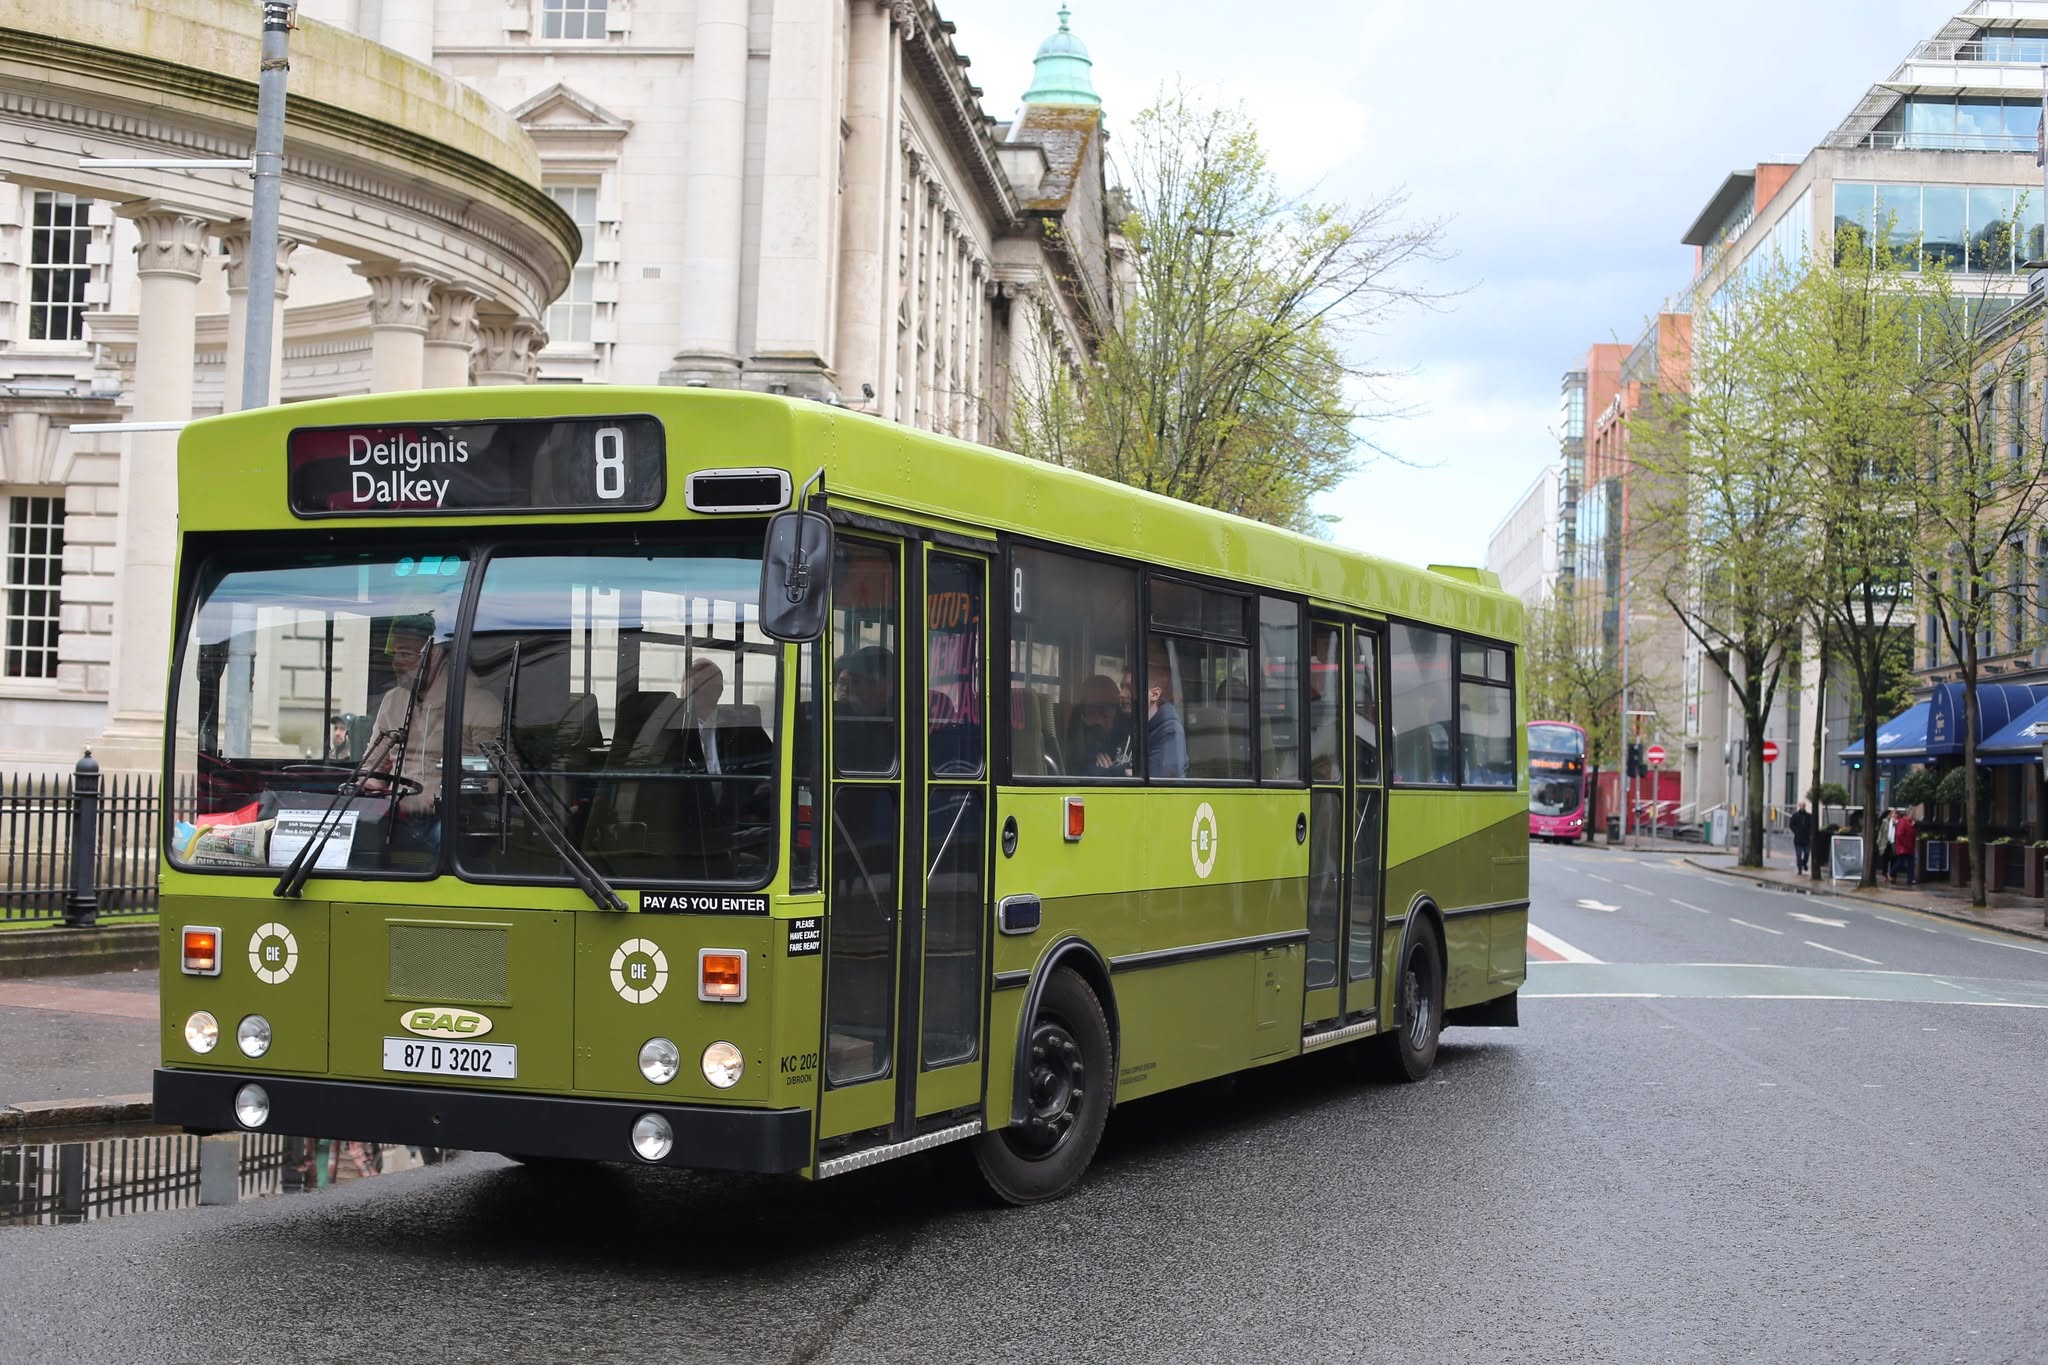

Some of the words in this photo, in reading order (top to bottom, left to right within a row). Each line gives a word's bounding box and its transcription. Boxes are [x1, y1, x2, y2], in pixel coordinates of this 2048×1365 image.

[349, 433, 469, 472] Deilginis
[595, 427, 625, 499] 8
[352, 470, 450, 508] Dalkey
[1014, 567, 1023, 613] 8
[643, 896, 667, 909] PAY
[670, 897, 688, 909] AS
[691, 897, 718, 910] YOU
[721, 898, 765, 911] ENTER
[795, 919, 815, 929] PLEASE
[790, 931, 803, 940] HAVE
[804, 930, 820, 939] EXACT
[266, 946, 280, 961] CIE
[789, 942, 803, 952] FARE
[803, 941, 820, 951] READY
[631, 963, 647, 979] CIE
[404, 1044, 425, 1068] 87
[432, 1046, 441, 1069] D
[449, 1047, 492, 1073] 3202
[780, 1056, 797, 1073] KC
[800, 1053, 817, 1070] 202
